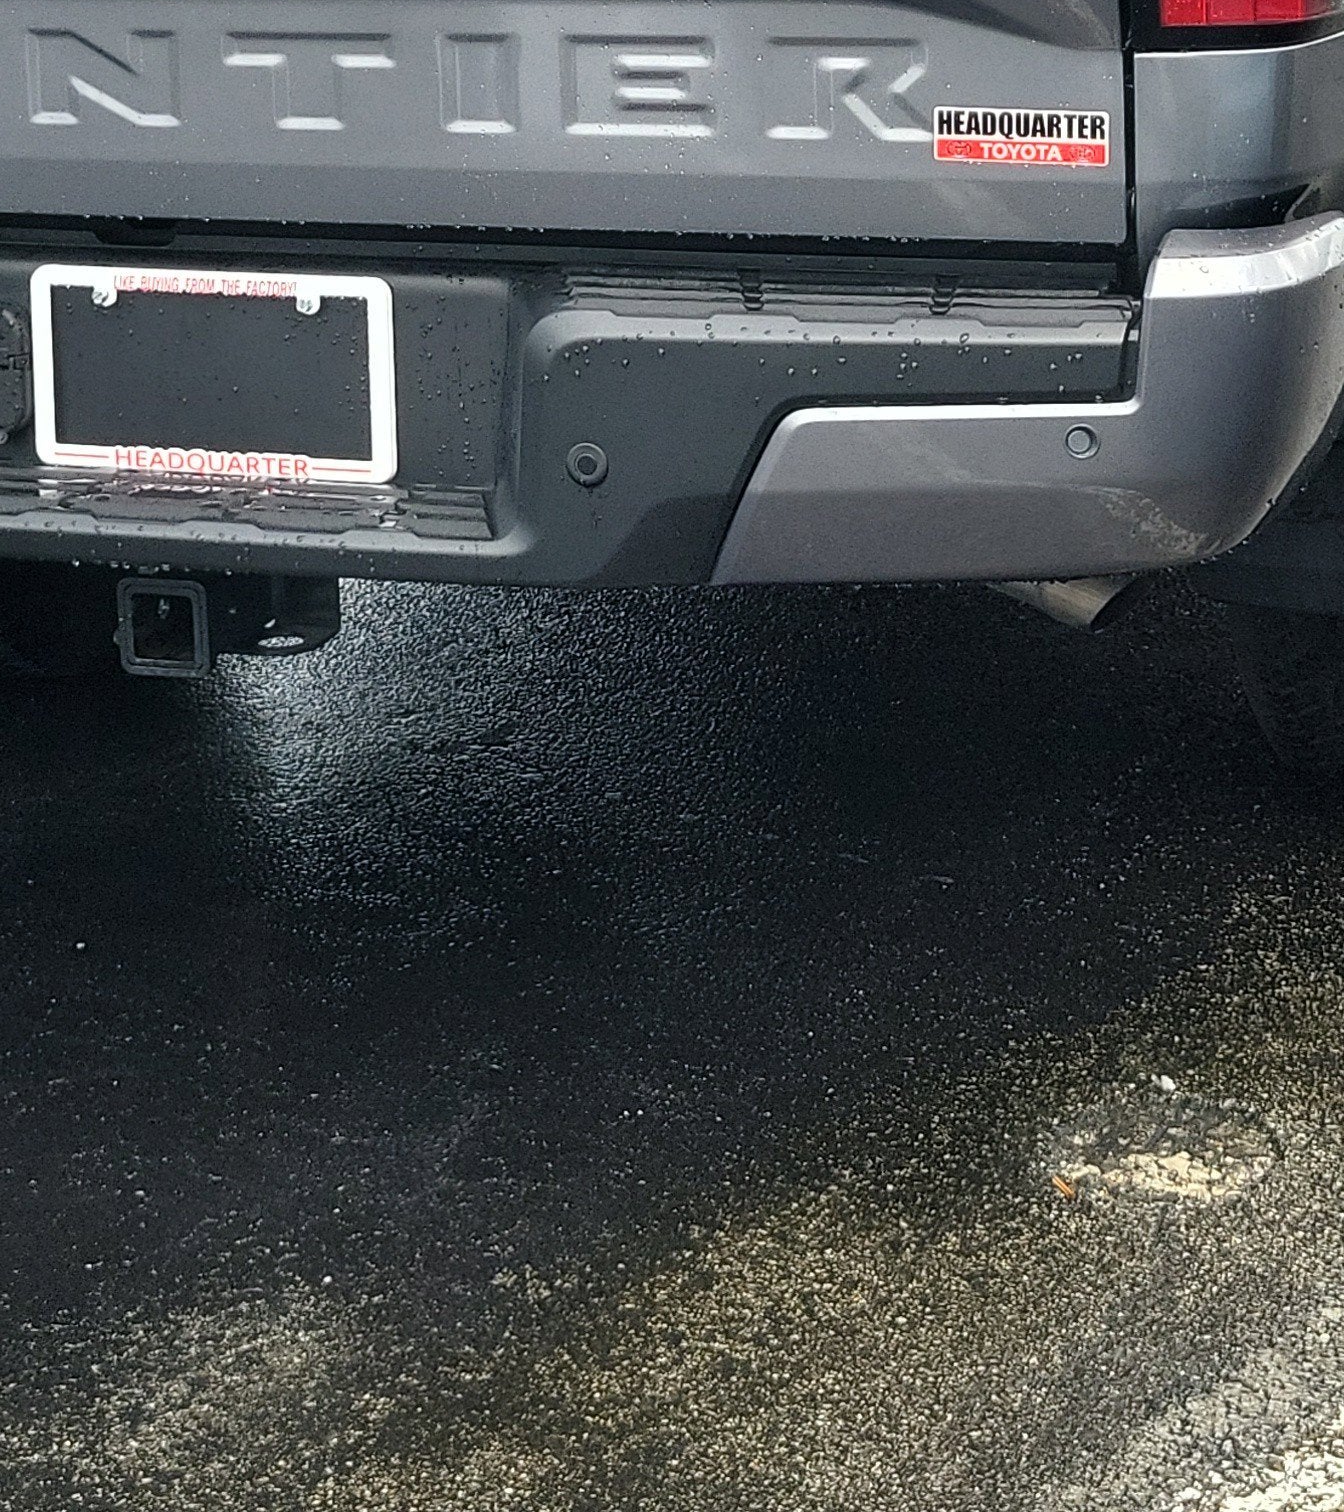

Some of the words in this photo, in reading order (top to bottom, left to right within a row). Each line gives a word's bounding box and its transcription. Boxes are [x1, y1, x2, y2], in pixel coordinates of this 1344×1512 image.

[937, 110, 1106, 140] HEADQUARTER
[979, 142, 1063, 162] TOYOTA
[113, 275, 135, 289] LIKE
[140, 275, 179, 291] BUYING
[185, 277, 215, 293] FROM
[221, 279, 241, 295] THE
[115, 449, 309, 477] HEADQUARTER
